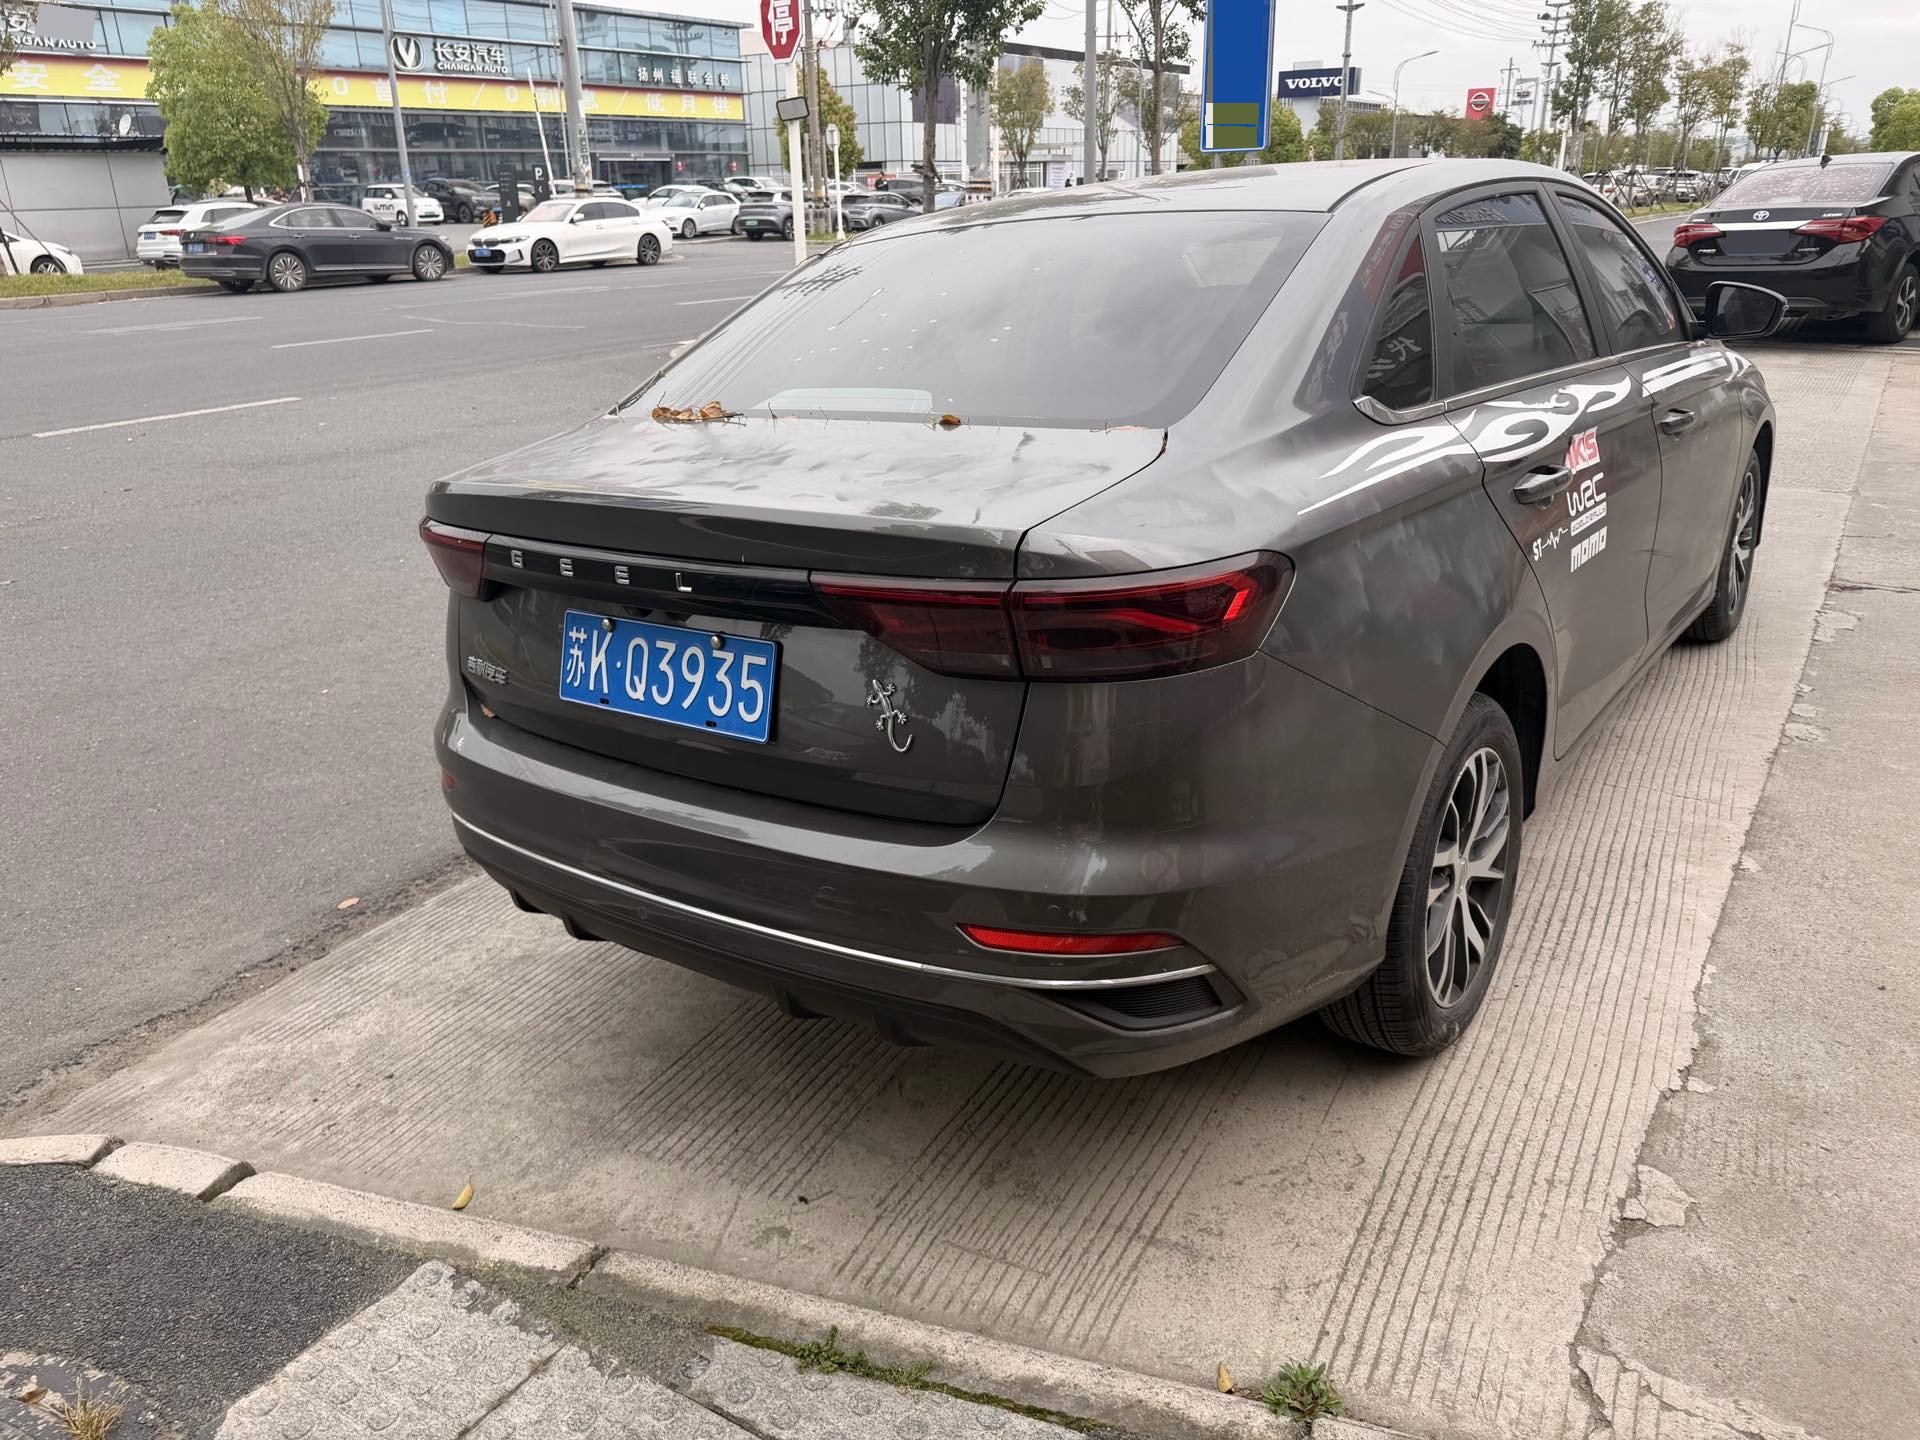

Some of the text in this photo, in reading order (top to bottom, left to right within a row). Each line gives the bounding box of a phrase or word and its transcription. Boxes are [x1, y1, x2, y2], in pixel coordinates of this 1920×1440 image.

[767, 0, 793, 46] 停
[58, 39, 97, 49] AUTO
[435, 42, 505, 64] 长安汽车
[437, 61, 482, 72] CHANGAN
[1285, 76, 1344, 89] VOLVO
[534, 167, 543, 181] P
[1567, 472, 1607, 517] WRC
[566, 626, 767, 723] 苏K·Q3935
